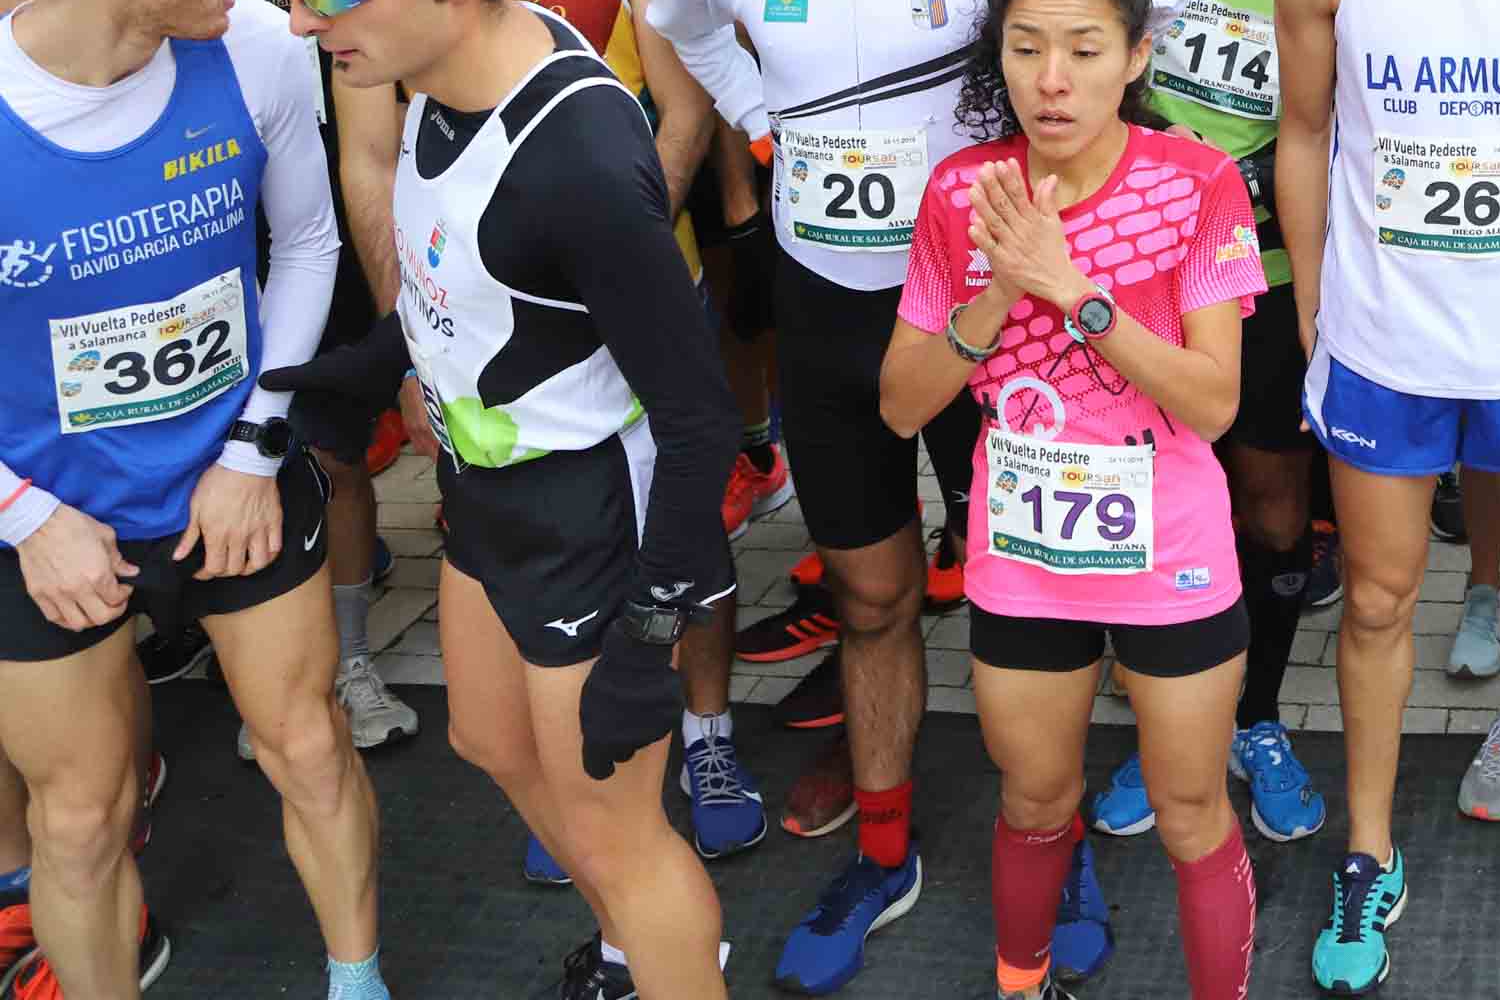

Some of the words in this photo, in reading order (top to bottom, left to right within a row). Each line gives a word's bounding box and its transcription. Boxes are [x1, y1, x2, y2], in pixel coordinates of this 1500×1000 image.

[1211, 2, 1251, 22] Pedestre
[1185, 33, 1272, 90] 114
[1366, 53, 1402, 91] LA
[1168, 79, 1186, 91] CAJA
[1186, 84, 1210, 99] RURAL
[1219, 94, 1271, 113] SALAMANCA
[1200, 78, 1245, 95] FRANCISCO
[1245, 90, 1274, 101] JAVIER
[1384, 99, 1417, 114] CLUB
[796, 133, 820, 149] Vuelta
[822, 135, 867, 149] Pedestre
[1379, 136, 1391, 150] VII
[1394, 140, 1426, 156] Vuelta
[1430, 144, 1477, 157] Pedestre
[163, 138, 241, 181] BIKILA
[794, 147, 834, 161] Salamanca
[1383, 155, 1389, 163] a
[1391, 155, 1440, 169] Salamanca
[823, 173, 896, 219] 20
[1424, 181, 1500, 226] 26
[62, 177, 244, 261] FISIOTERAPIA
[807, 231, 824, 241] CAJA
[825, 234, 850, 243] RURAL
[852, 235, 865, 243] DE
[1398, 236, 1419, 246] CAJA
[1421, 240, 1450, 249] RURAL
[1454, 241, 1466, 249] DE
[1452, 227, 1482, 235] DIEGO
[70, 253, 120, 280] DAVID
[122, 232, 180, 265] GARCÍA
[182, 207, 245, 246] CATALINA
[59, 323, 78, 338] VII
[81, 316, 126, 334] Vuelta
[130, 302, 187, 326] Pedestre
[68, 342, 76, 351] a
[79, 331, 147, 348] Salamanca
[103, 320, 232, 395] 362
[213, 355, 242, 375] DAVID
[94, 408, 125, 420] CAJA
[127, 402, 165, 415] RURAL
[167, 398, 184, 410] DE
[185, 368, 243, 405] SALAMANCA
[991, 437, 1004, 451] VII
[1004, 438, 1037, 460] Vuelta
[1040, 447, 1090, 465] Pedestre
[997, 456, 1002, 465] a
[1004, 457, 1051, 478] Salamanca
[1022, 485, 1137, 542] 179
[1011, 543, 1034, 557] CAJA
[1035, 548, 1060, 564] RURAL
[1062, 555, 1076, 565] DE
[1078, 555, 1146, 567] SALAMANCA
[1109, 543, 1147, 551] JUANA
